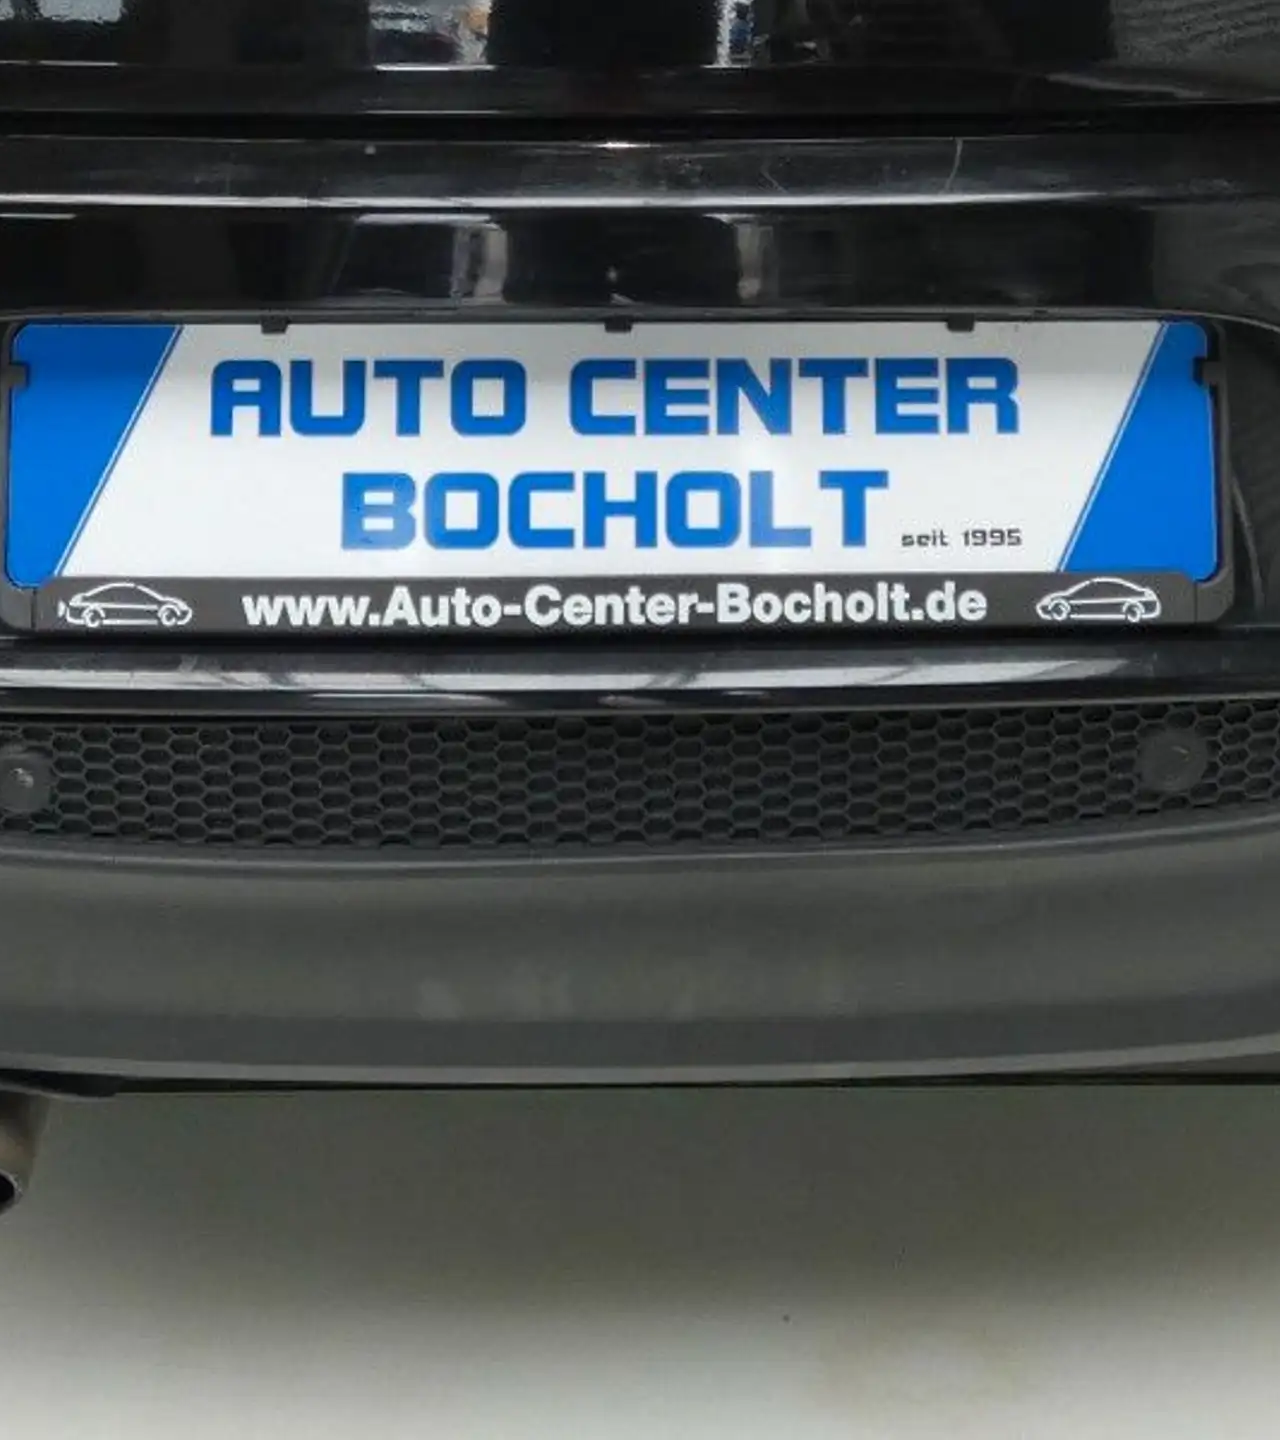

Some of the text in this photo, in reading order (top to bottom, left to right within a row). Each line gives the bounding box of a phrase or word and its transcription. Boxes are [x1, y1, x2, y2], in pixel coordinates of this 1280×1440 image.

[210, 357, 1020, 438] AUTO CENTER
[340, 470, 889, 551] BOCHOLT
[901, 527, 1023, 548] seit 1995
[241, 580, 988, 628] www.Auto-Center-Bocholt.de
